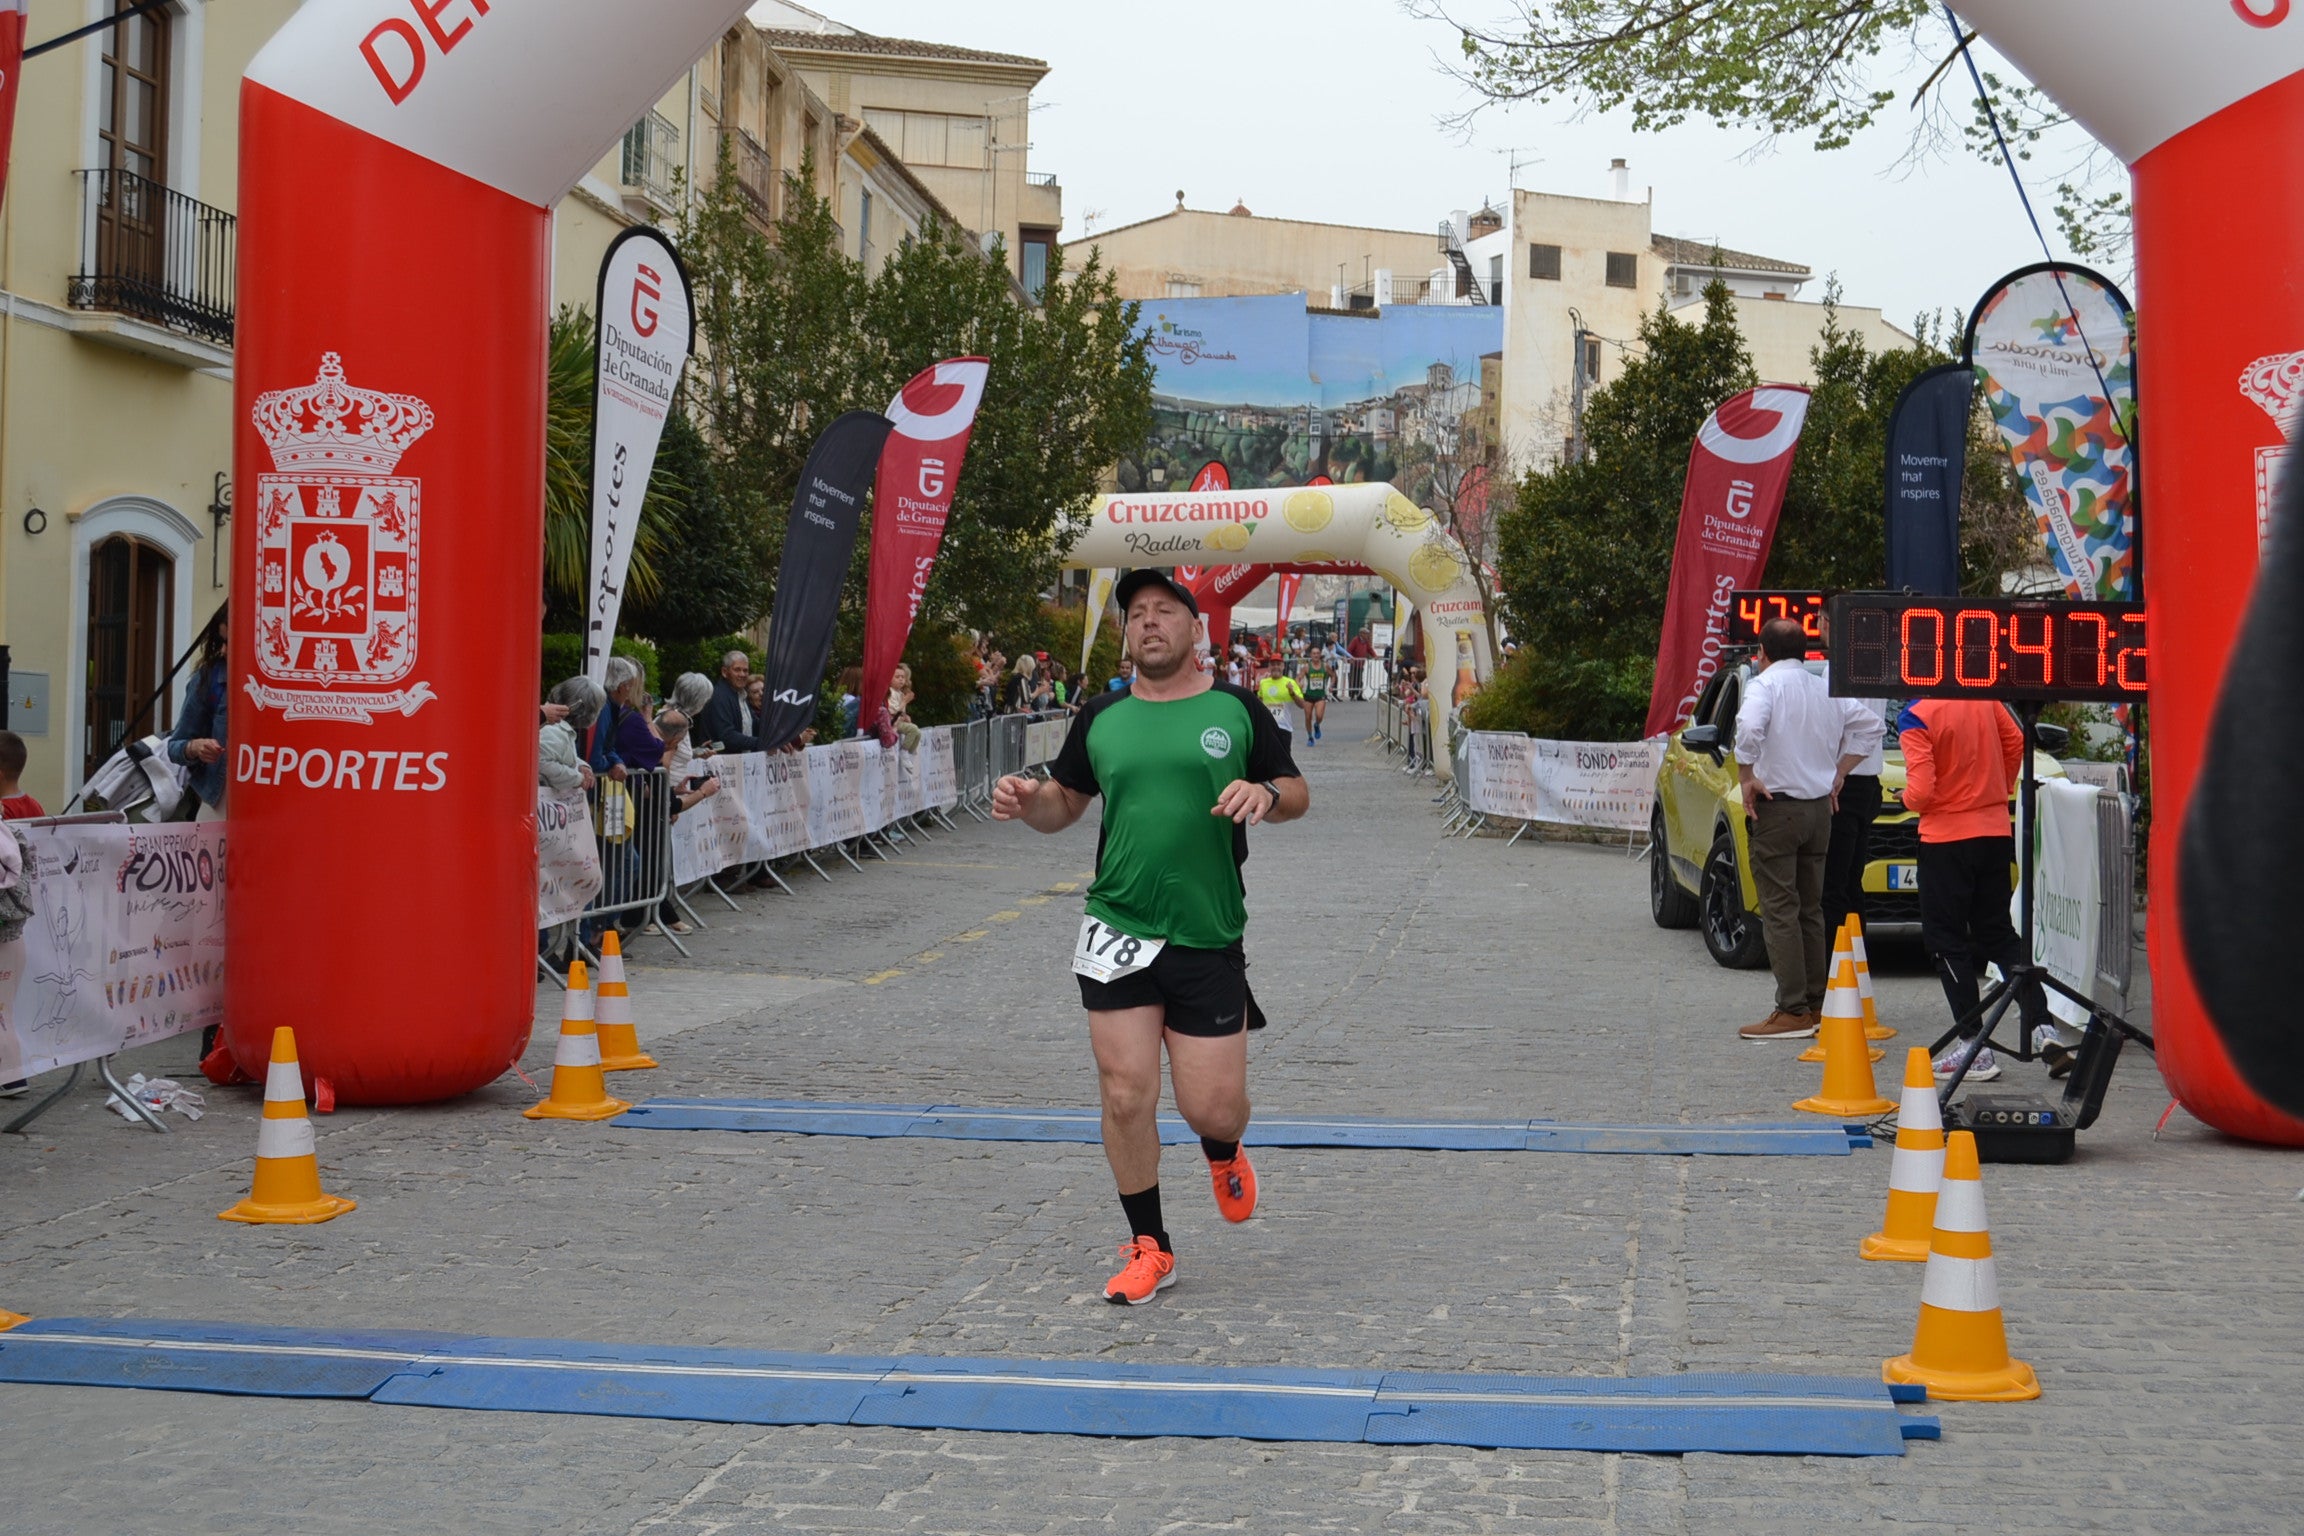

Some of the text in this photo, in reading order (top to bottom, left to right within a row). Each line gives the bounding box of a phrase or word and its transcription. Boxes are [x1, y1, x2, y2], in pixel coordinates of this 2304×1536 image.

[359, 0, 491, 107] DE
[1172, 323, 1202, 338] Turismo
[605, 323, 673, 377] Diputación
[602, 352, 670, 401] de Granada
[1901, 471, 1922, 483] that
[809, 493, 826, 508] that
[812, 476, 855, 506] Movement
[1900, 488, 1941, 501] inspires
[804, 507, 836, 530] inspires
[896, 510, 910, 522] de
[1108, 499, 1268, 523] Cruzcampo
[1704, 514, 1763, 538] Diputación
[1124, 532, 1202, 556] Radler
[1701, 528, 1761, 550] de Granada
[293, 702, 358, 716] GRANADA
[236, 743, 449, 792] DEPORTES
[1577, 753, 1617, 770] FONDO
[135, 836, 162, 854] GRAN
[163, 834, 198, 852] PREMIO
[120, 848, 213, 894] FONDO
[1085, 921, 1142, 967] 178
